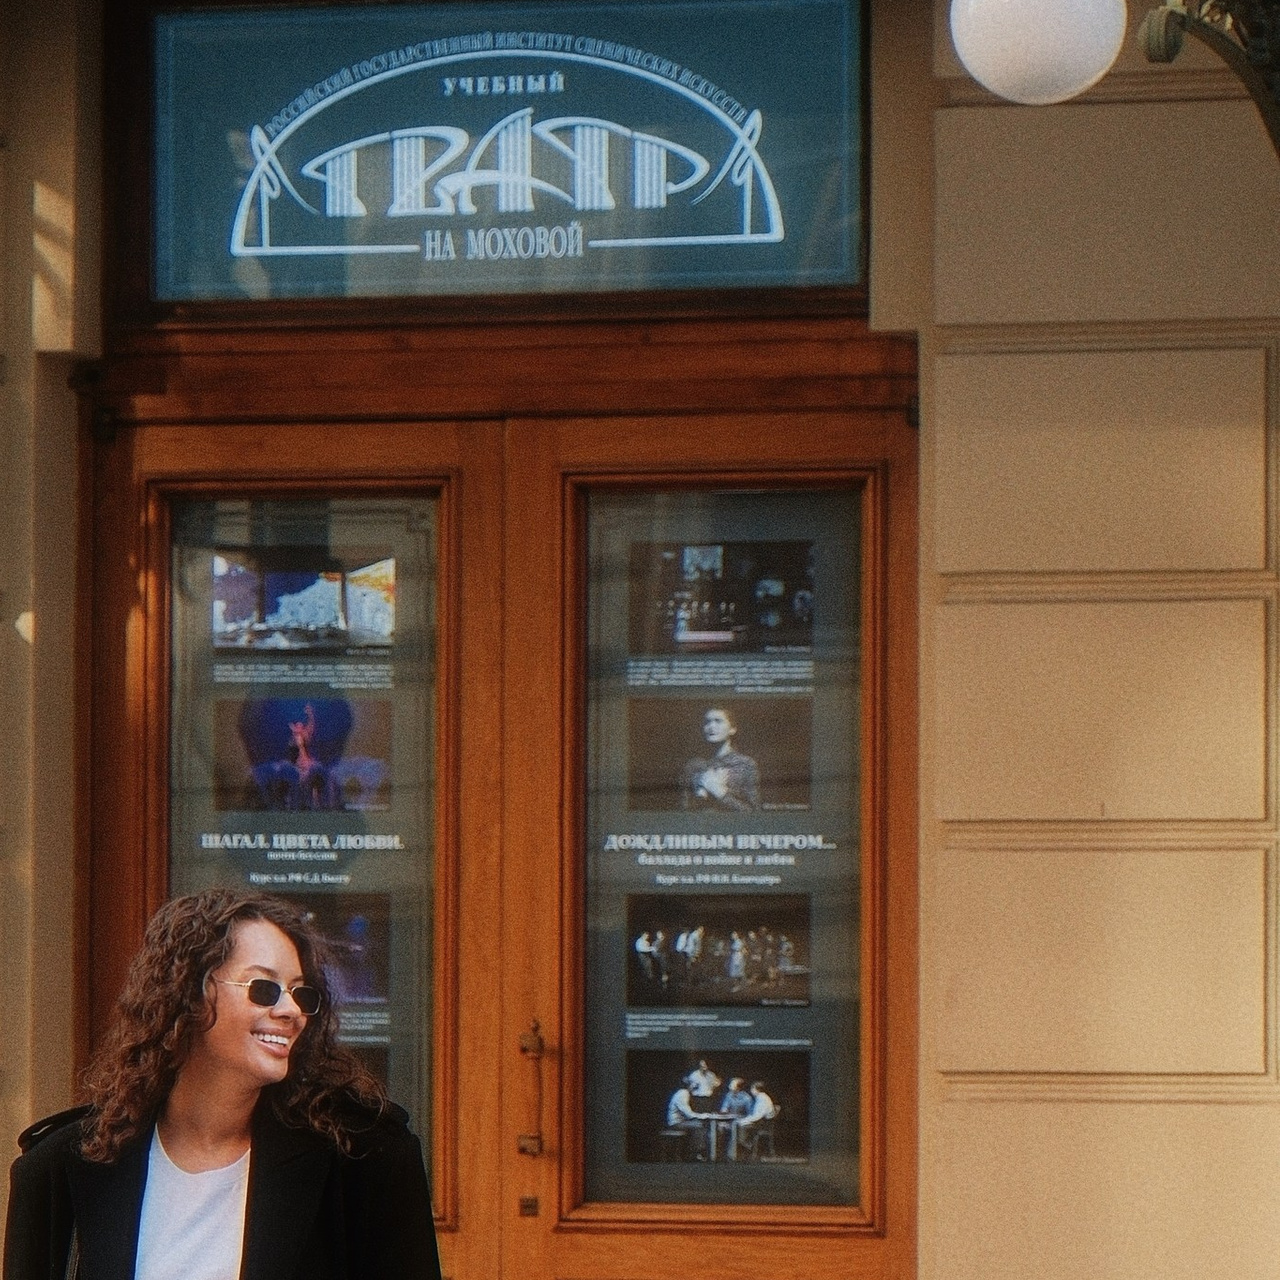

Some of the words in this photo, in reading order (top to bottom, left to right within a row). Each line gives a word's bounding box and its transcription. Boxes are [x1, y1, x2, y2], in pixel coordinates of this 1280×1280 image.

[264, 67, 355, 137] РОССИЙСКИЙ
[352, 31, 493, 81] ГОСУДАРСТВЕННЫЙ
[495, 32, 572, 50] ИНСТИТУТ
[575, 36, 680, 80] СЦЕНИЧЕСКИХ
[678, 68, 748, 124] ИСКУССТВ
[443, 71, 565, 96] УЧЕБНЫЙ
[424, 229, 456, 261] НА
[466, 221, 584, 261] МОХОВОЙ
[201, 833, 270, 850] ШАГАЛ.
[272, 833, 331, 852] ЦВЕТА
[603, 834, 734, 852] ДОЖДЛИВЫМ
[736, 834, 837, 850] ВЕЧЕРОМ...
